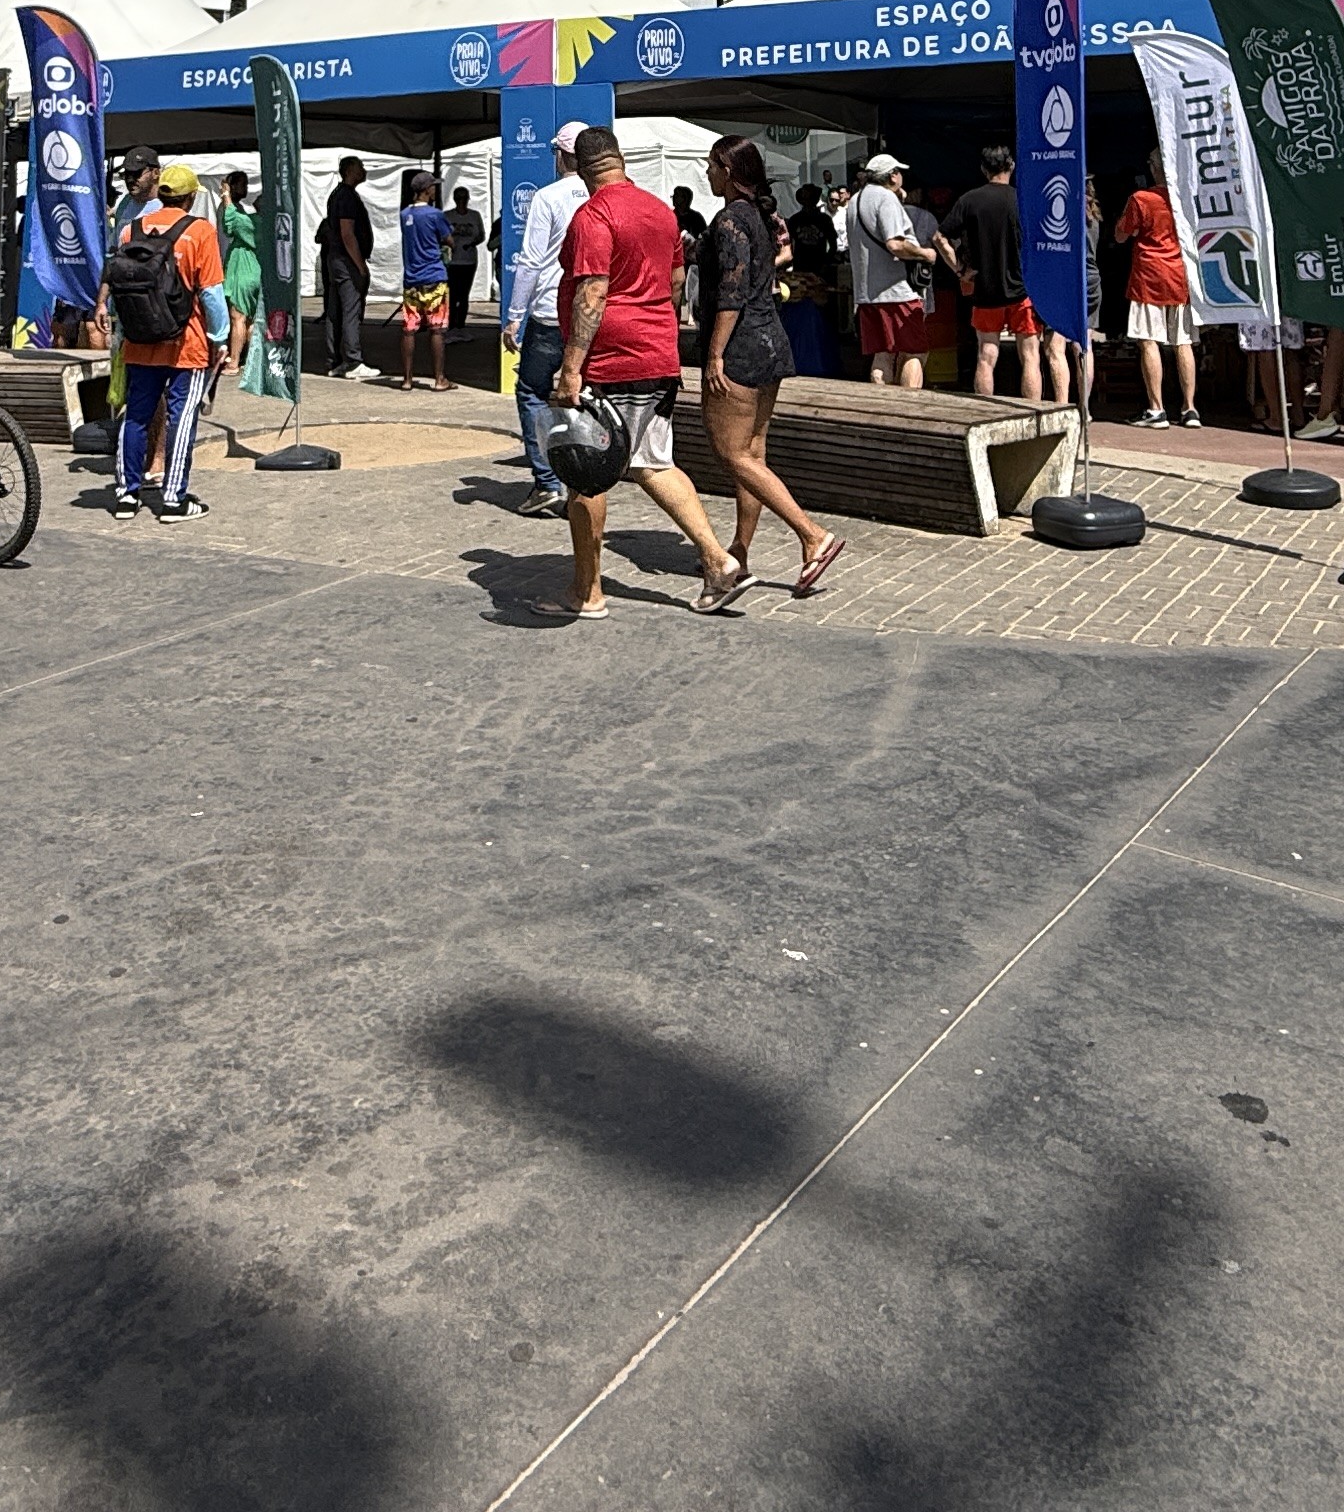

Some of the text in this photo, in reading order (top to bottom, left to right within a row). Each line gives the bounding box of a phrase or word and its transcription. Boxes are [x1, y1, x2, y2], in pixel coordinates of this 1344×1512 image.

[876, 0, 992, 27] ESPAÇO
[456, 41, 484, 59] PRAIA
[644, 28, 676, 48] PRAIA
[721, 39, 892, 68] PREFEITURA
[902, 35, 940, 57] DE
[951, 25, 1014, 55] JOÃ
[458, 60, 481, 76] VIVA
[646, 47, 673, 66] VIVA
[1271, 51, 1315, 152] AMIGOS
[1291, 41, 1335, 160] DA PRAIA
[1178, 70, 1234, 219] Emlur
[1219, 84, 1243, 195] CRIATIVA
